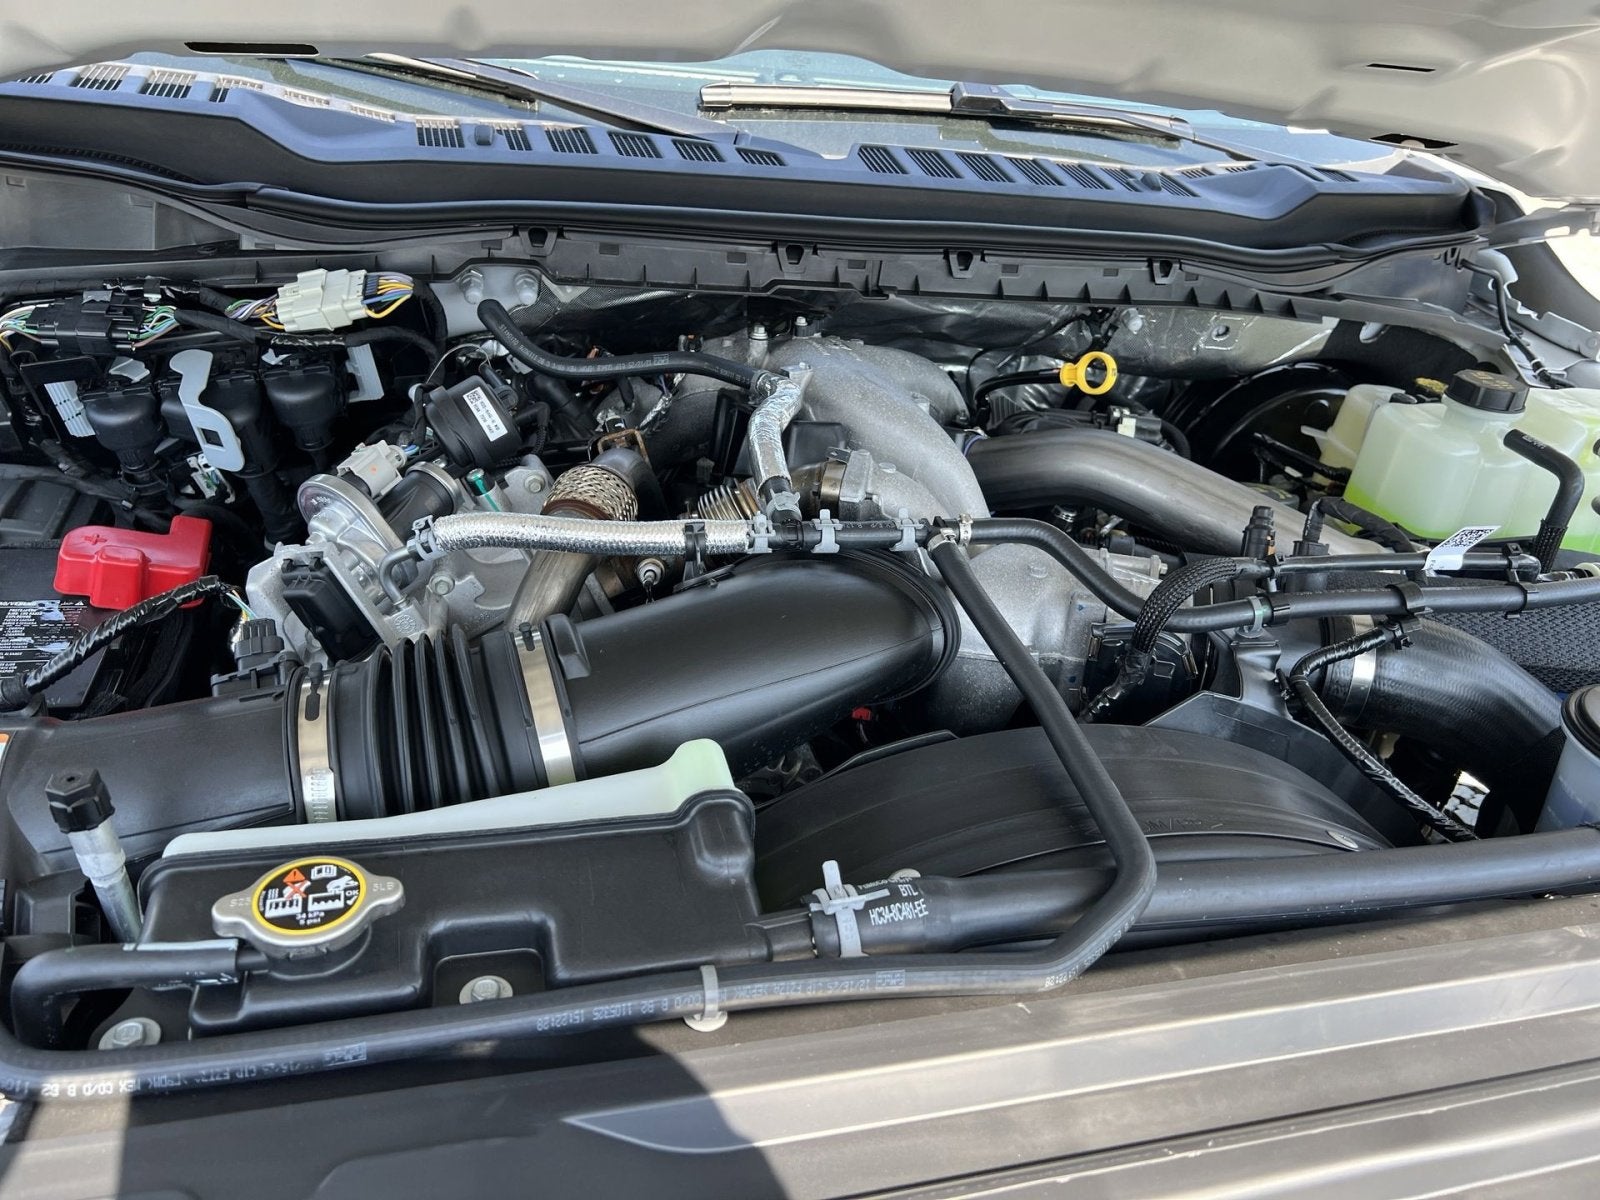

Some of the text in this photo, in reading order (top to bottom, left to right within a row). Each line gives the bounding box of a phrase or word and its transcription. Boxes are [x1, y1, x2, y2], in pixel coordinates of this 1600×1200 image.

[345, 889, 359, 897] OK
[898, 883, 919, 897] BTL
[308, 911, 325, 919] kPa
[306, 917, 321, 926] psi
